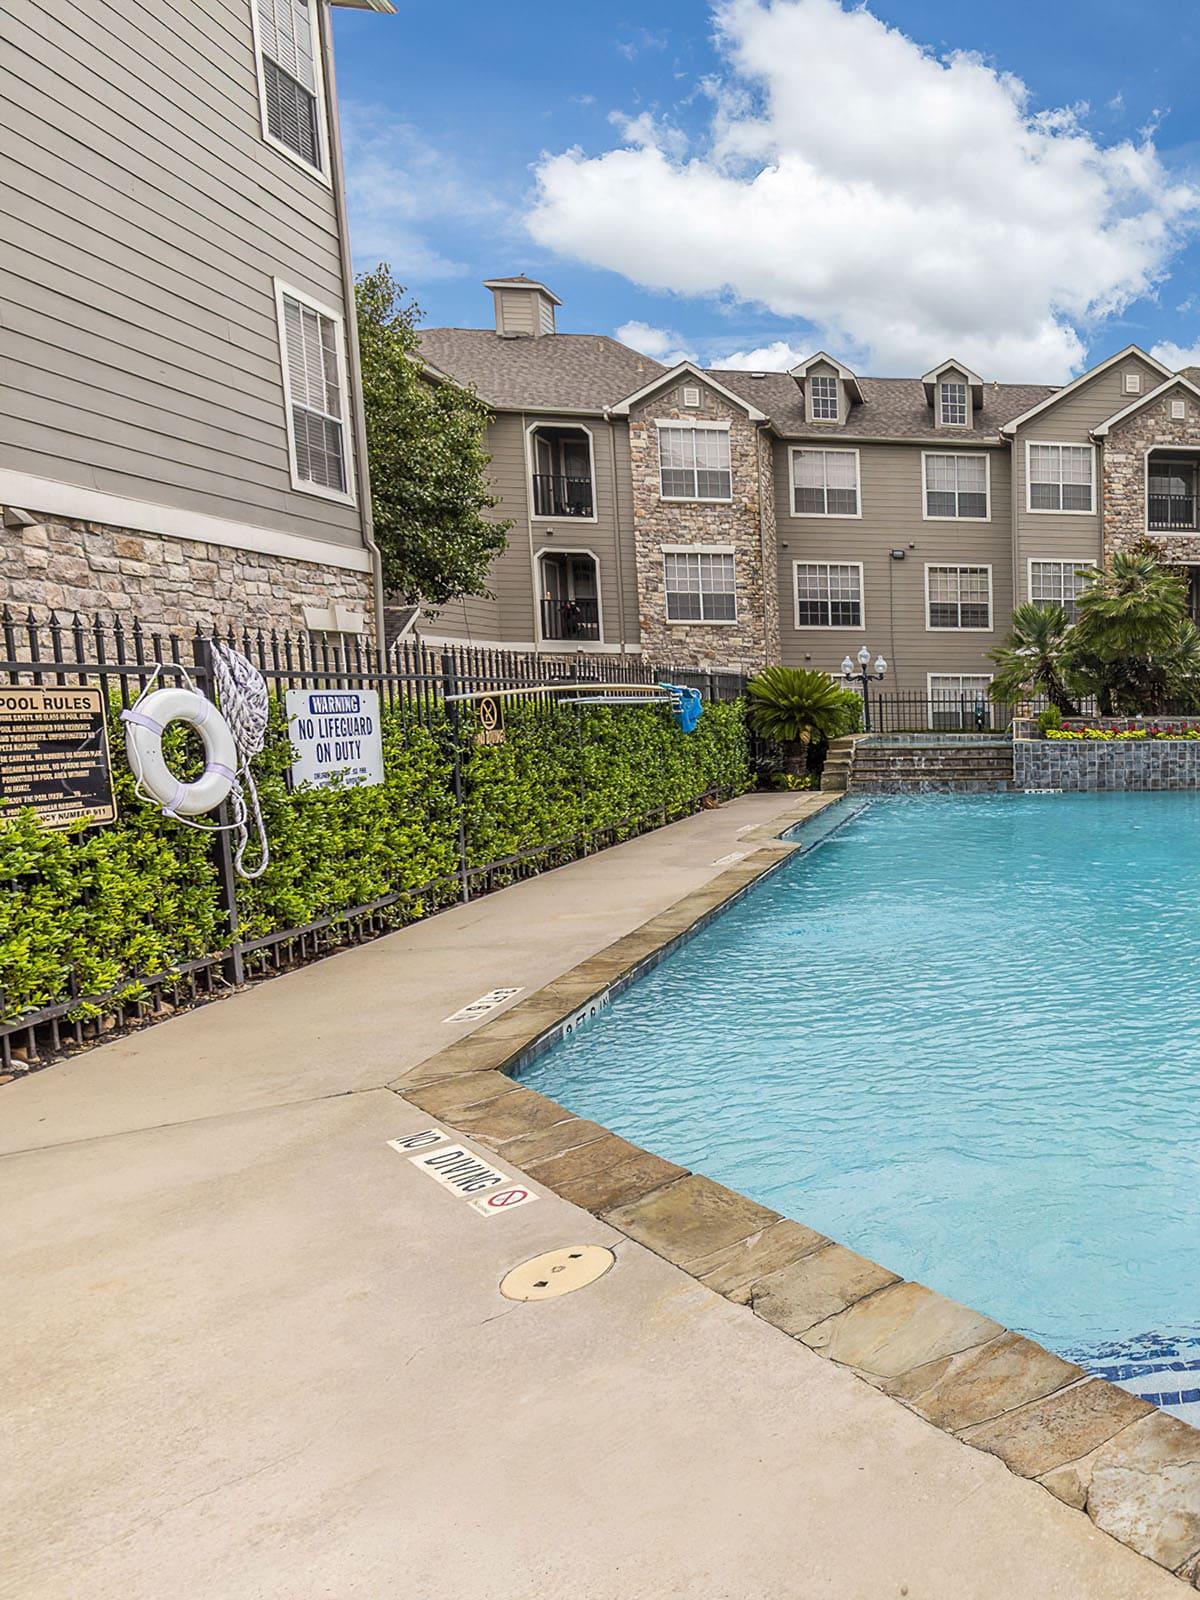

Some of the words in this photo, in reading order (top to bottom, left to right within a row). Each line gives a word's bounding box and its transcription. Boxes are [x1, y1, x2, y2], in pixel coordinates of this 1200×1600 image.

[43, 697, 91, 710] RULES
[312, 696, 358, 713] WARNING
[298, 718, 314, 740] NO
[318, 716, 373, 738] LIFEGUARD
[316, 742, 331, 763] ON
[335, 740, 361, 761] DUTY
[396, 1130, 441, 1148] NO
[424, 1150, 502, 1191] DIVING
